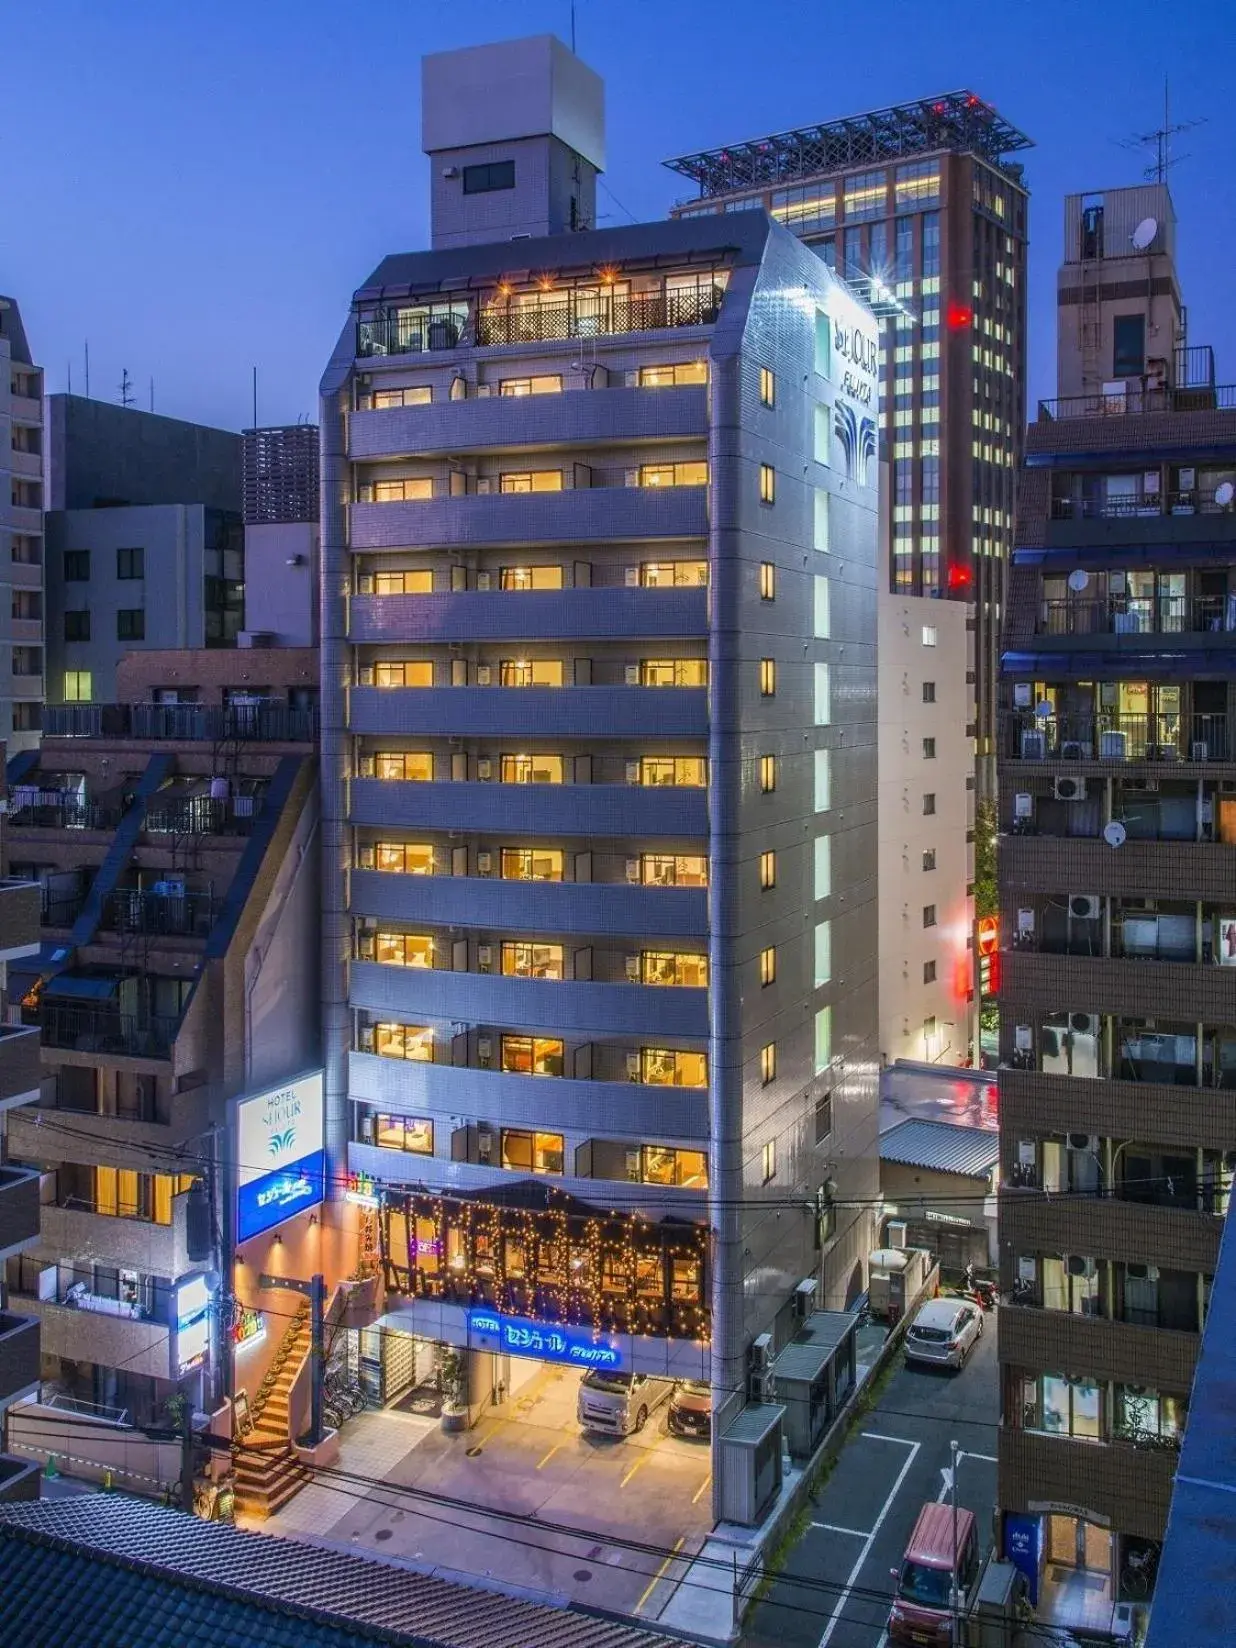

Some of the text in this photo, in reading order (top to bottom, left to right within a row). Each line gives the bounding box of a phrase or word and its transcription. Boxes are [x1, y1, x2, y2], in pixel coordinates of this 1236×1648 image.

[266, 1090, 296, 1108] HOTEL
[472, 1317, 616, 1363] HOTEL セジュール FUJITA
